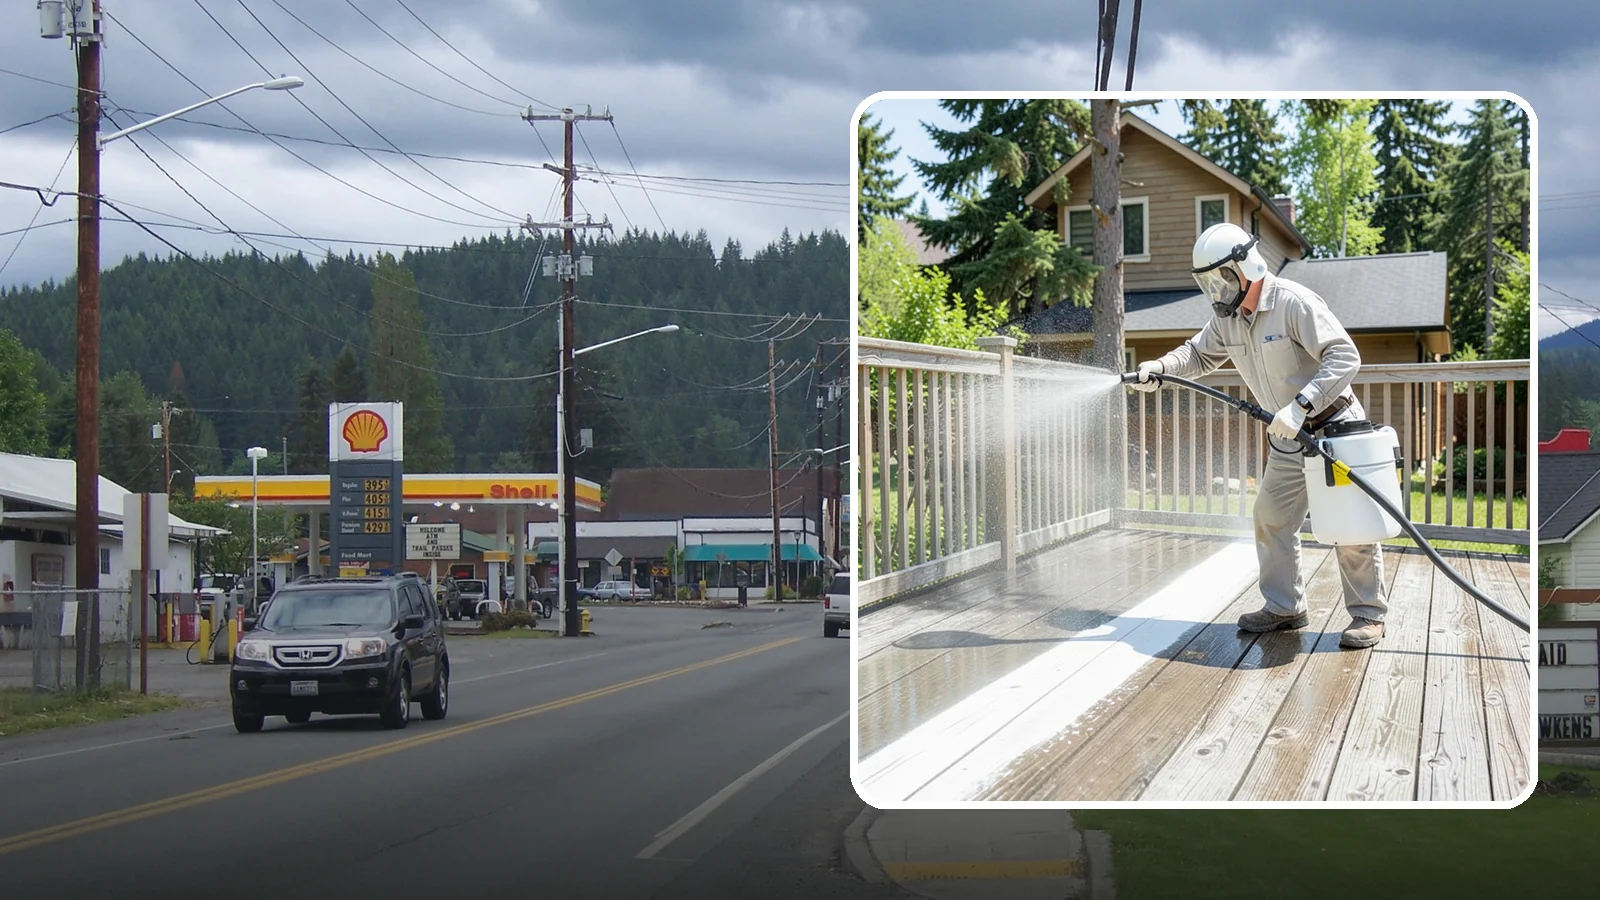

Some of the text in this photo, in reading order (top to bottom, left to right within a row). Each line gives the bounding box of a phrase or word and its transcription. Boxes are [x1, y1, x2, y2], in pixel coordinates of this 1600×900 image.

[366, 480, 384, 490] 395
[490, 484, 547, 499] Shell
[366, 494, 384, 504] 405
[366, 508, 383, 518] 415
[366, 522, 383, 532] 429
